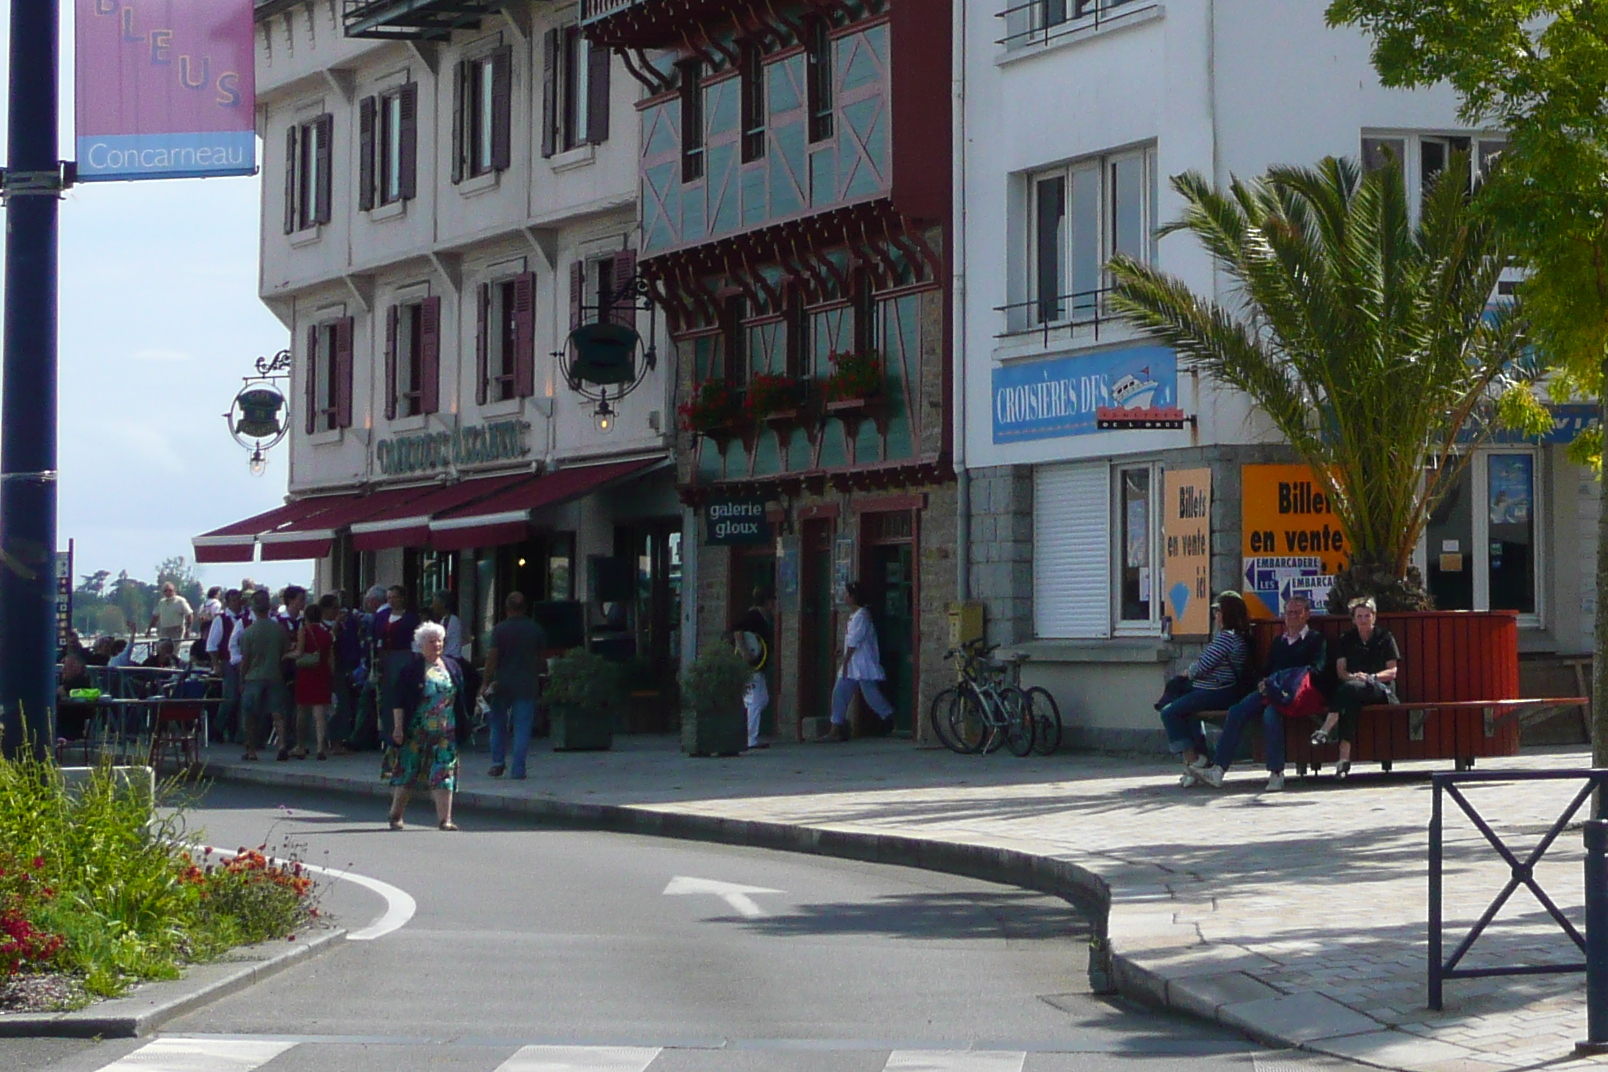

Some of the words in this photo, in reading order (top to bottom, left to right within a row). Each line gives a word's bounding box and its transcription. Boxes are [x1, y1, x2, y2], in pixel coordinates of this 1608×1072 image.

[88, 142, 244, 169] Concarneau
[997, 370, 1076, 424] CROISIÈRES
[1081, 374, 1109, 413] DES
[710, 501, 762, 520] galerie
[1179, 485, 1207, 519] Billets
[716, 520, 758, 538] gloux
[1167, 534, 1178, 557] en
[1182, 529, 1206, 555] vente
[1250, 530, 1275, 552] en
[1284, 524, 1343, 552] vente
[1196, 565, 1206, 599] ici
